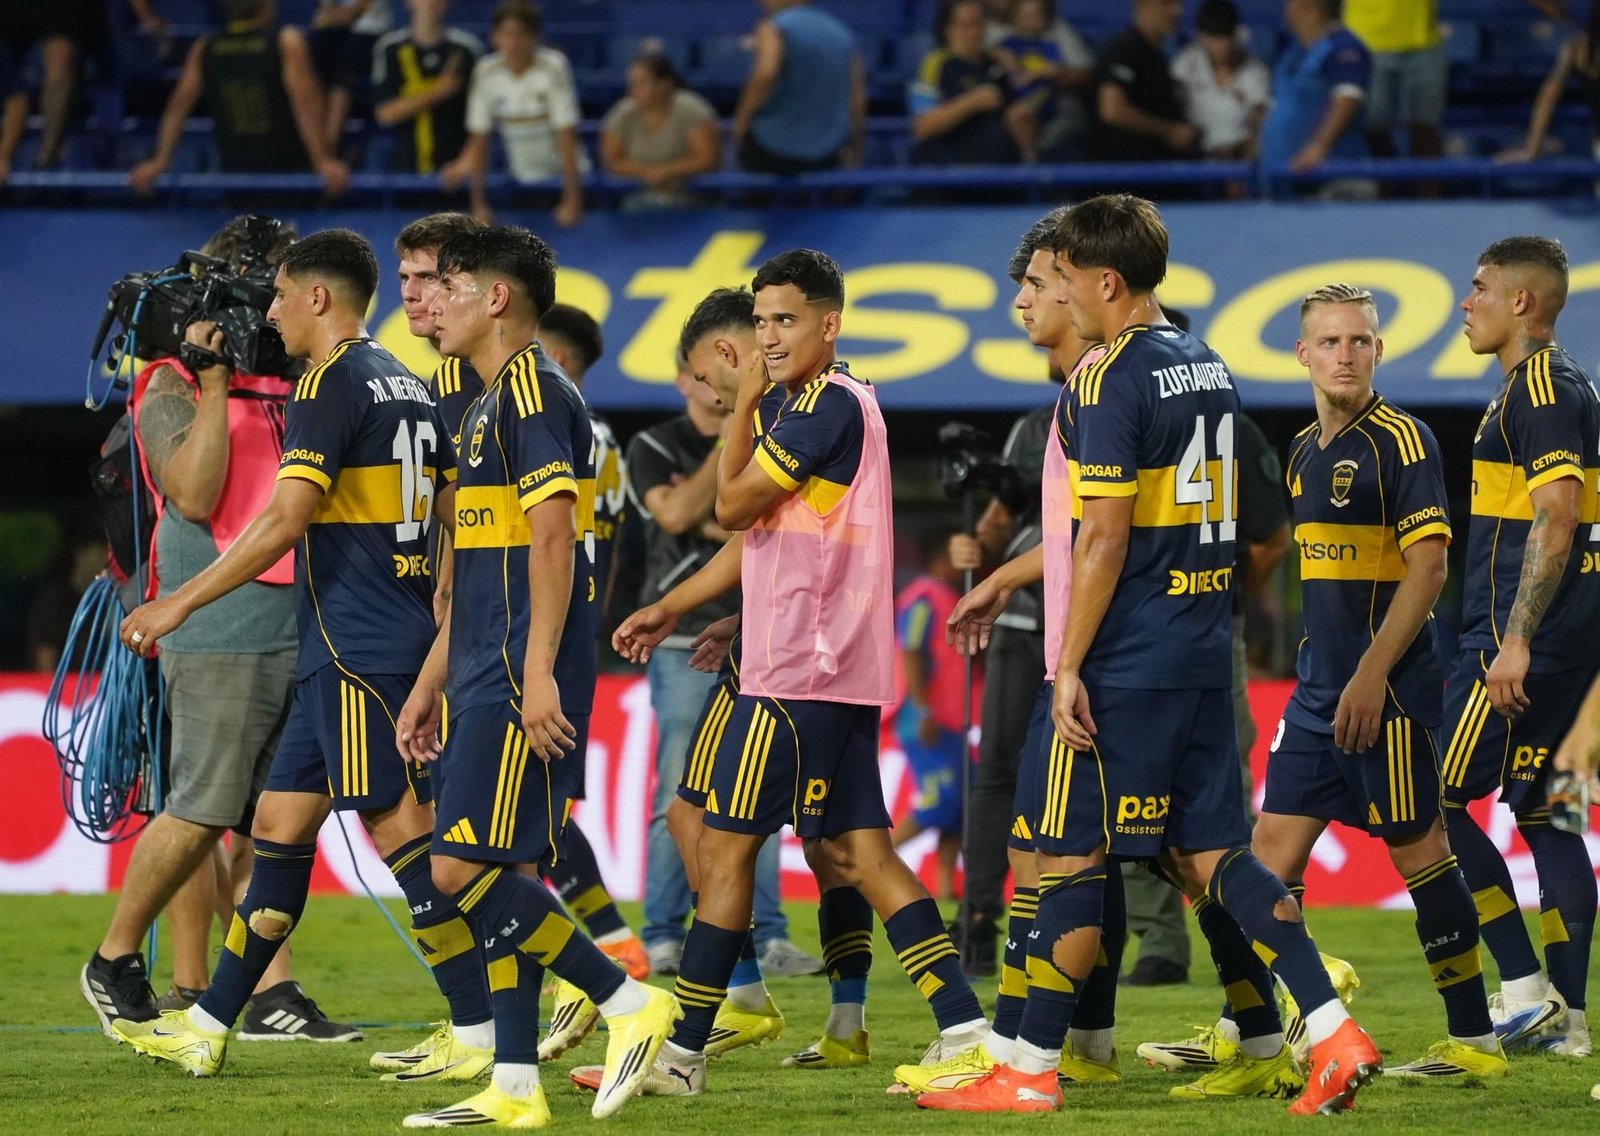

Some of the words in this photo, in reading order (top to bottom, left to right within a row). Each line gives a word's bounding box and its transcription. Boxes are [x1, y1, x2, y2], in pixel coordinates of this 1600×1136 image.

[1152, 362, 1233, 399] ZUFIAURRE
[1175, 413, 1237, 544] 41
[1532, 450, 1581, 472] CETROGAR
[393, 419, 437, 542] 16
[1167, 567, 1233, 596] DIRECT
